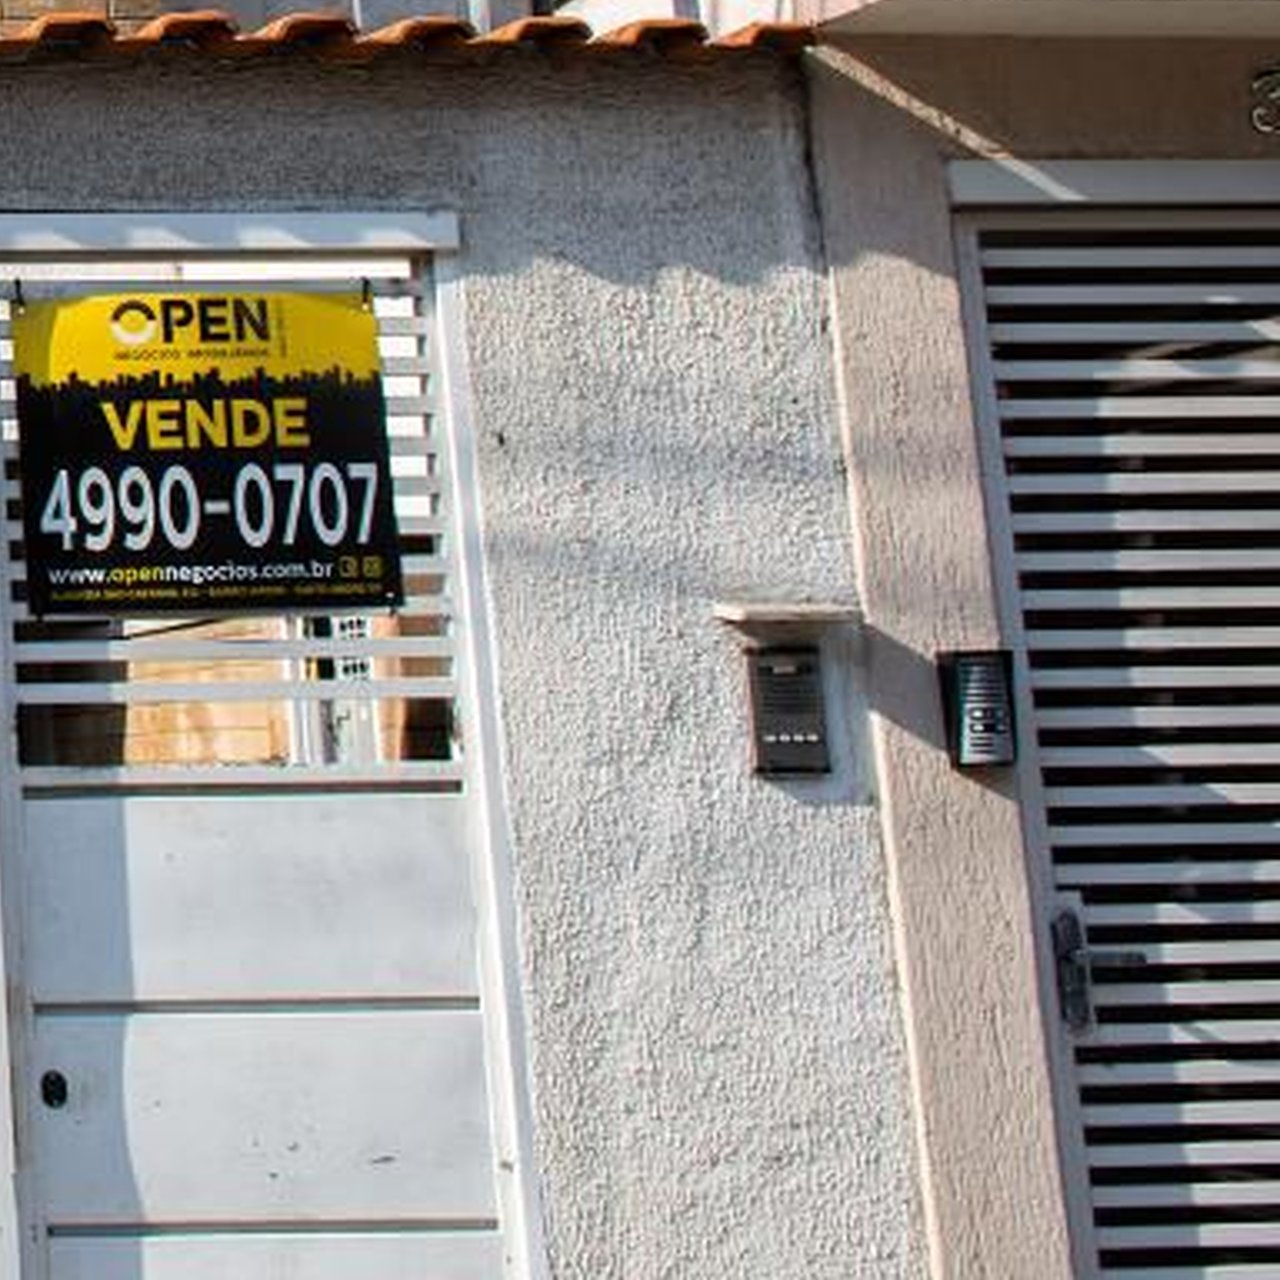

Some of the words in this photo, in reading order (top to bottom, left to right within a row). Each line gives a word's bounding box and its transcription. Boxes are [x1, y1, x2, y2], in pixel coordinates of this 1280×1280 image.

[111, 298, 270, 345] OPEN
[102, 397, 312, 452] VENDE
[40, 461, 380, 551] 4990-0707
[49, 559, 334, 584] www.opennegocios.com.br
